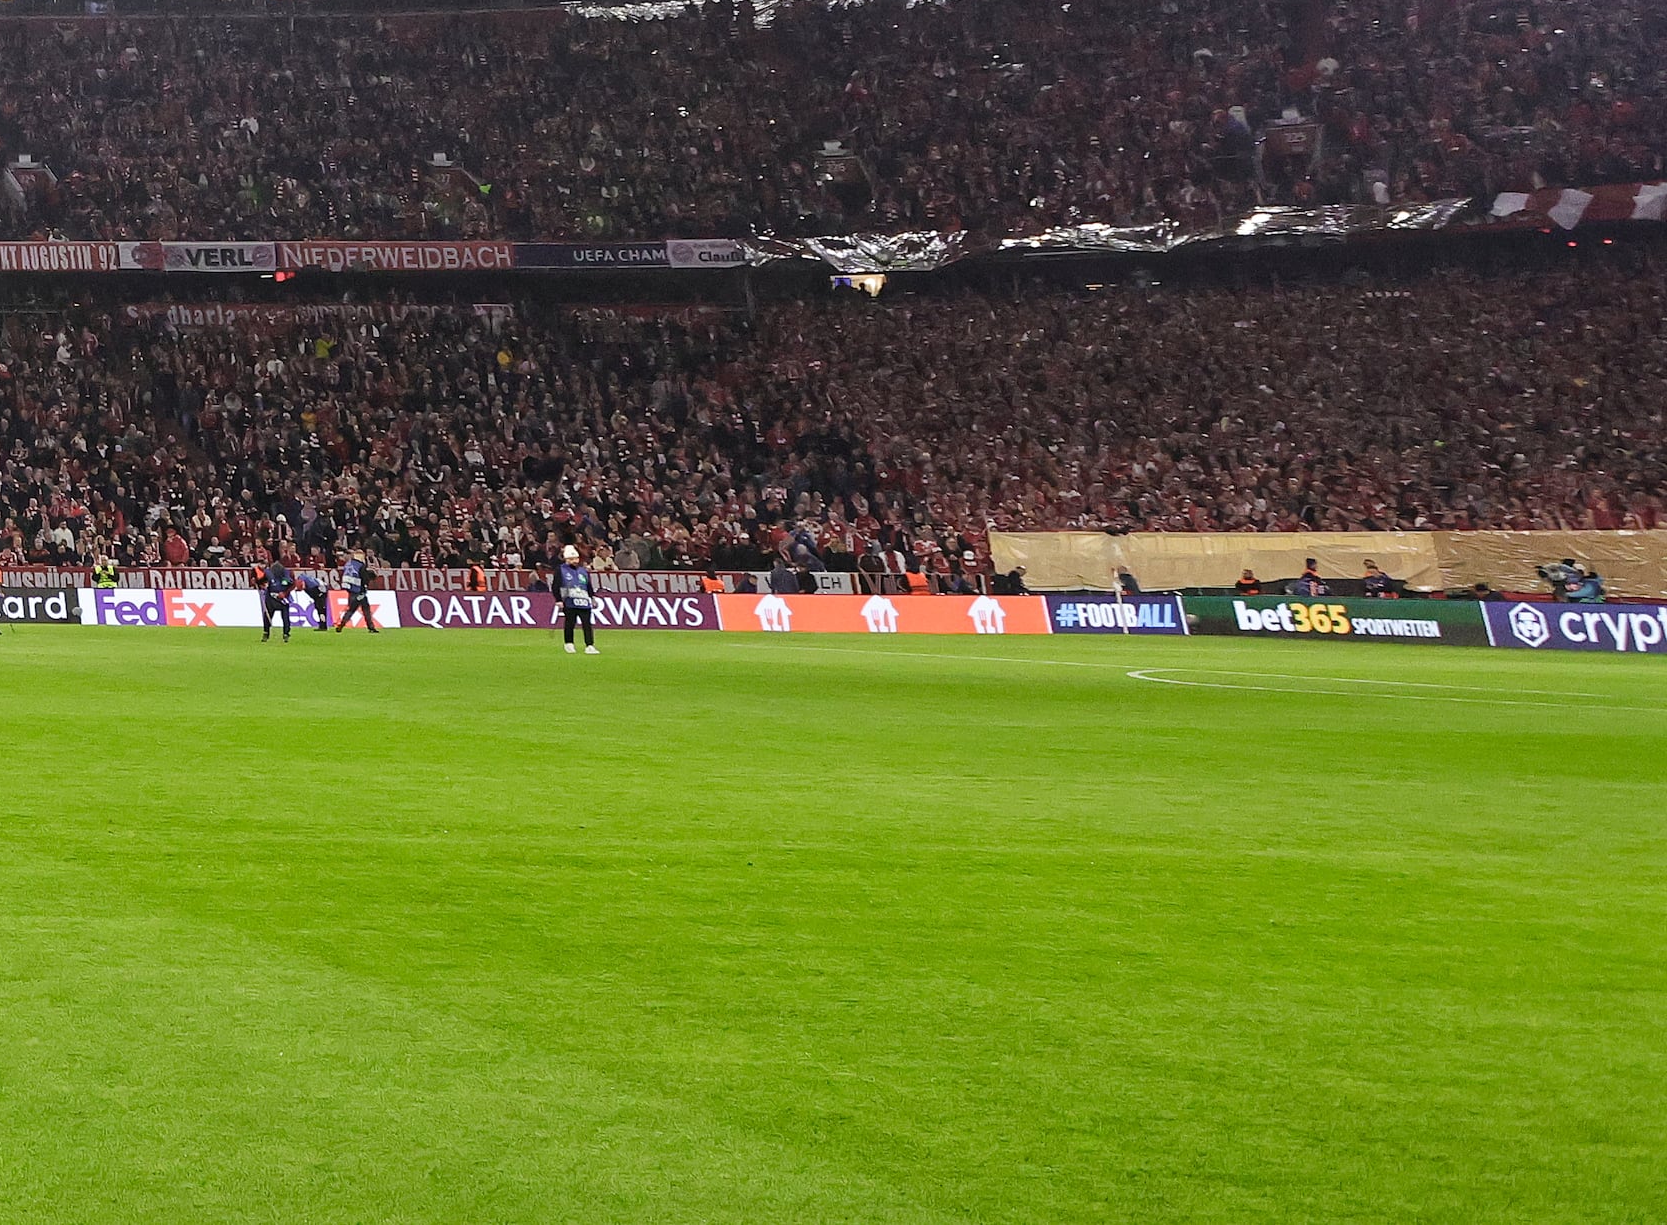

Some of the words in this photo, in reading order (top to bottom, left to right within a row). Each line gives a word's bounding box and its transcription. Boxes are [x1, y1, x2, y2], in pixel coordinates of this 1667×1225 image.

[21, 245, 92, 270] AUGUSTIN
[186, 247, 253, 267] VERL
[281, 244, 511, 270] NIEDERWEIDBACH
[574, 249, 616, 263] UEFA
[150, 569, 252, 589] DAUBORN
[377, 568, 526, 591] TAUBETAL
[95, 589, 217, 625] FedEx
[411, 594, 537, 628] QATAR
[1056, 603, 1177, 630] #FOOTBALL
[1233, 600, 1353, 634] bet365
[1351, 619, 1442, 640] SPORTWETTEN
